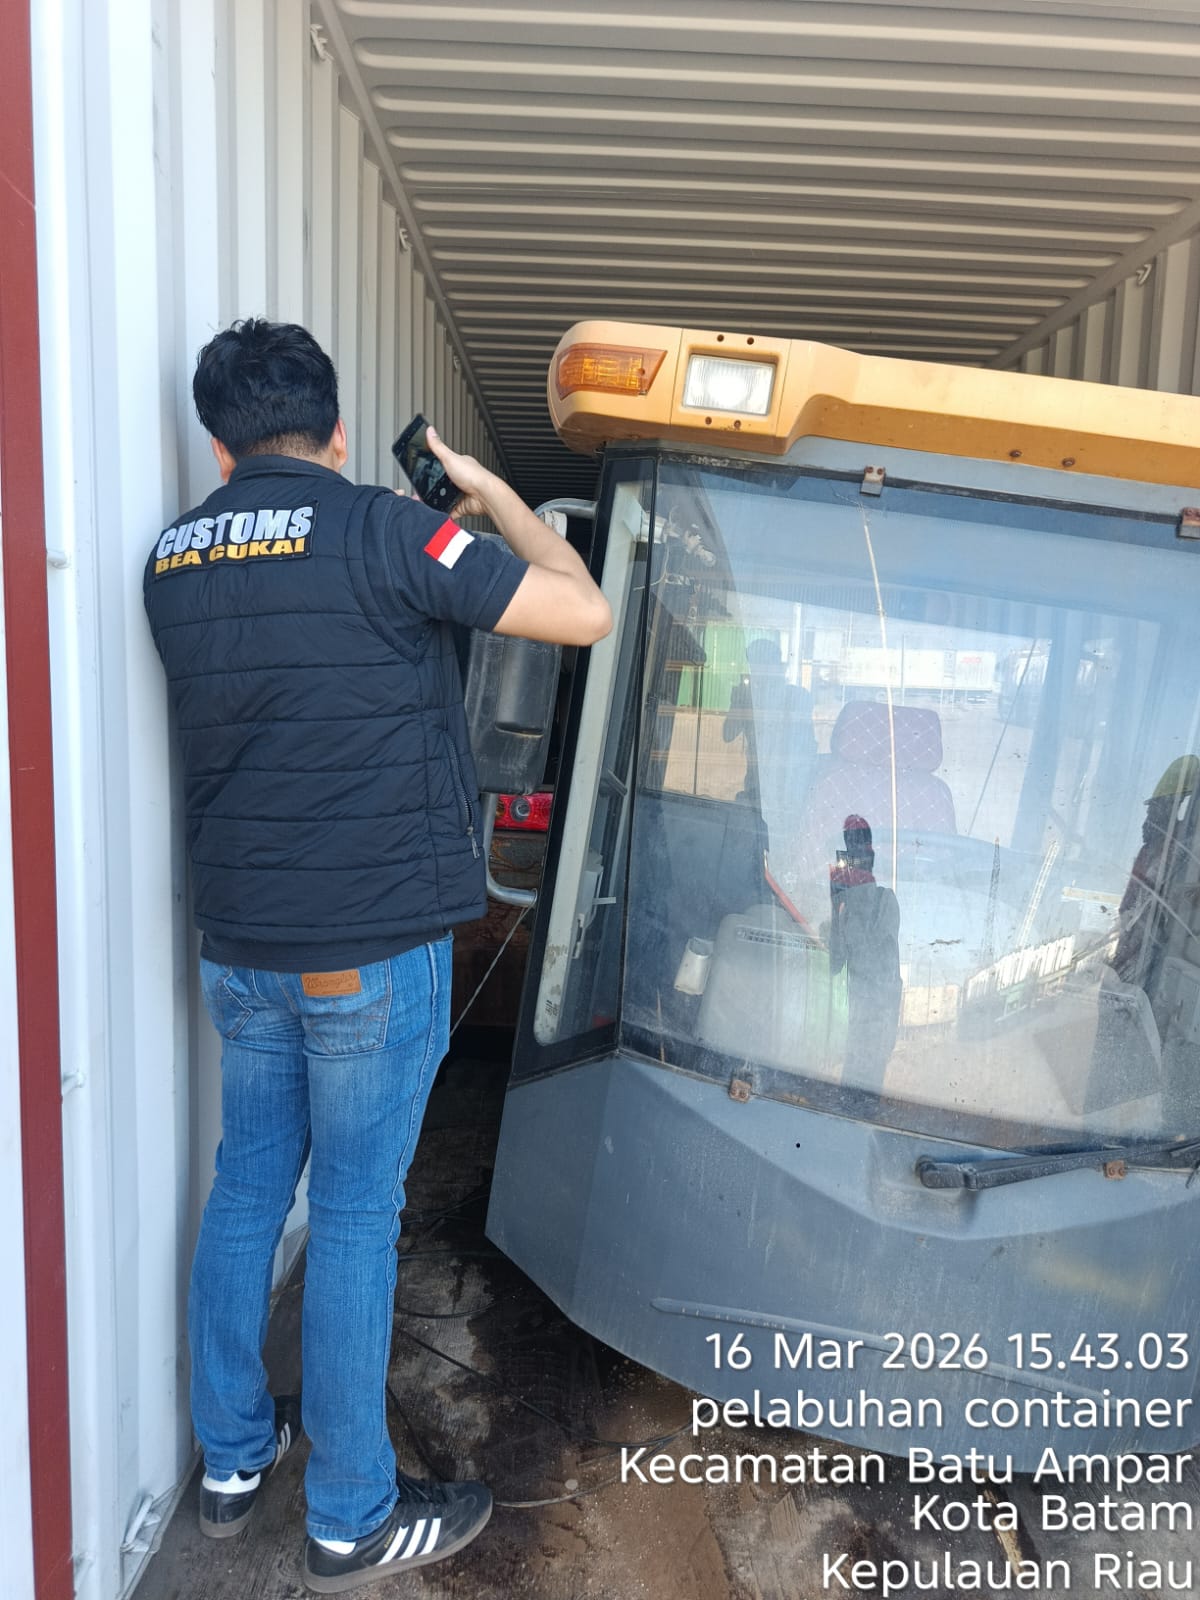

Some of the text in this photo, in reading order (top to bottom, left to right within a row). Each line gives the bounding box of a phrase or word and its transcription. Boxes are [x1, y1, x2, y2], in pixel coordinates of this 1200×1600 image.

[156, 506, 314, 559] CUSTOMS
[155, 537, 305, 574] BEA CUKAI
